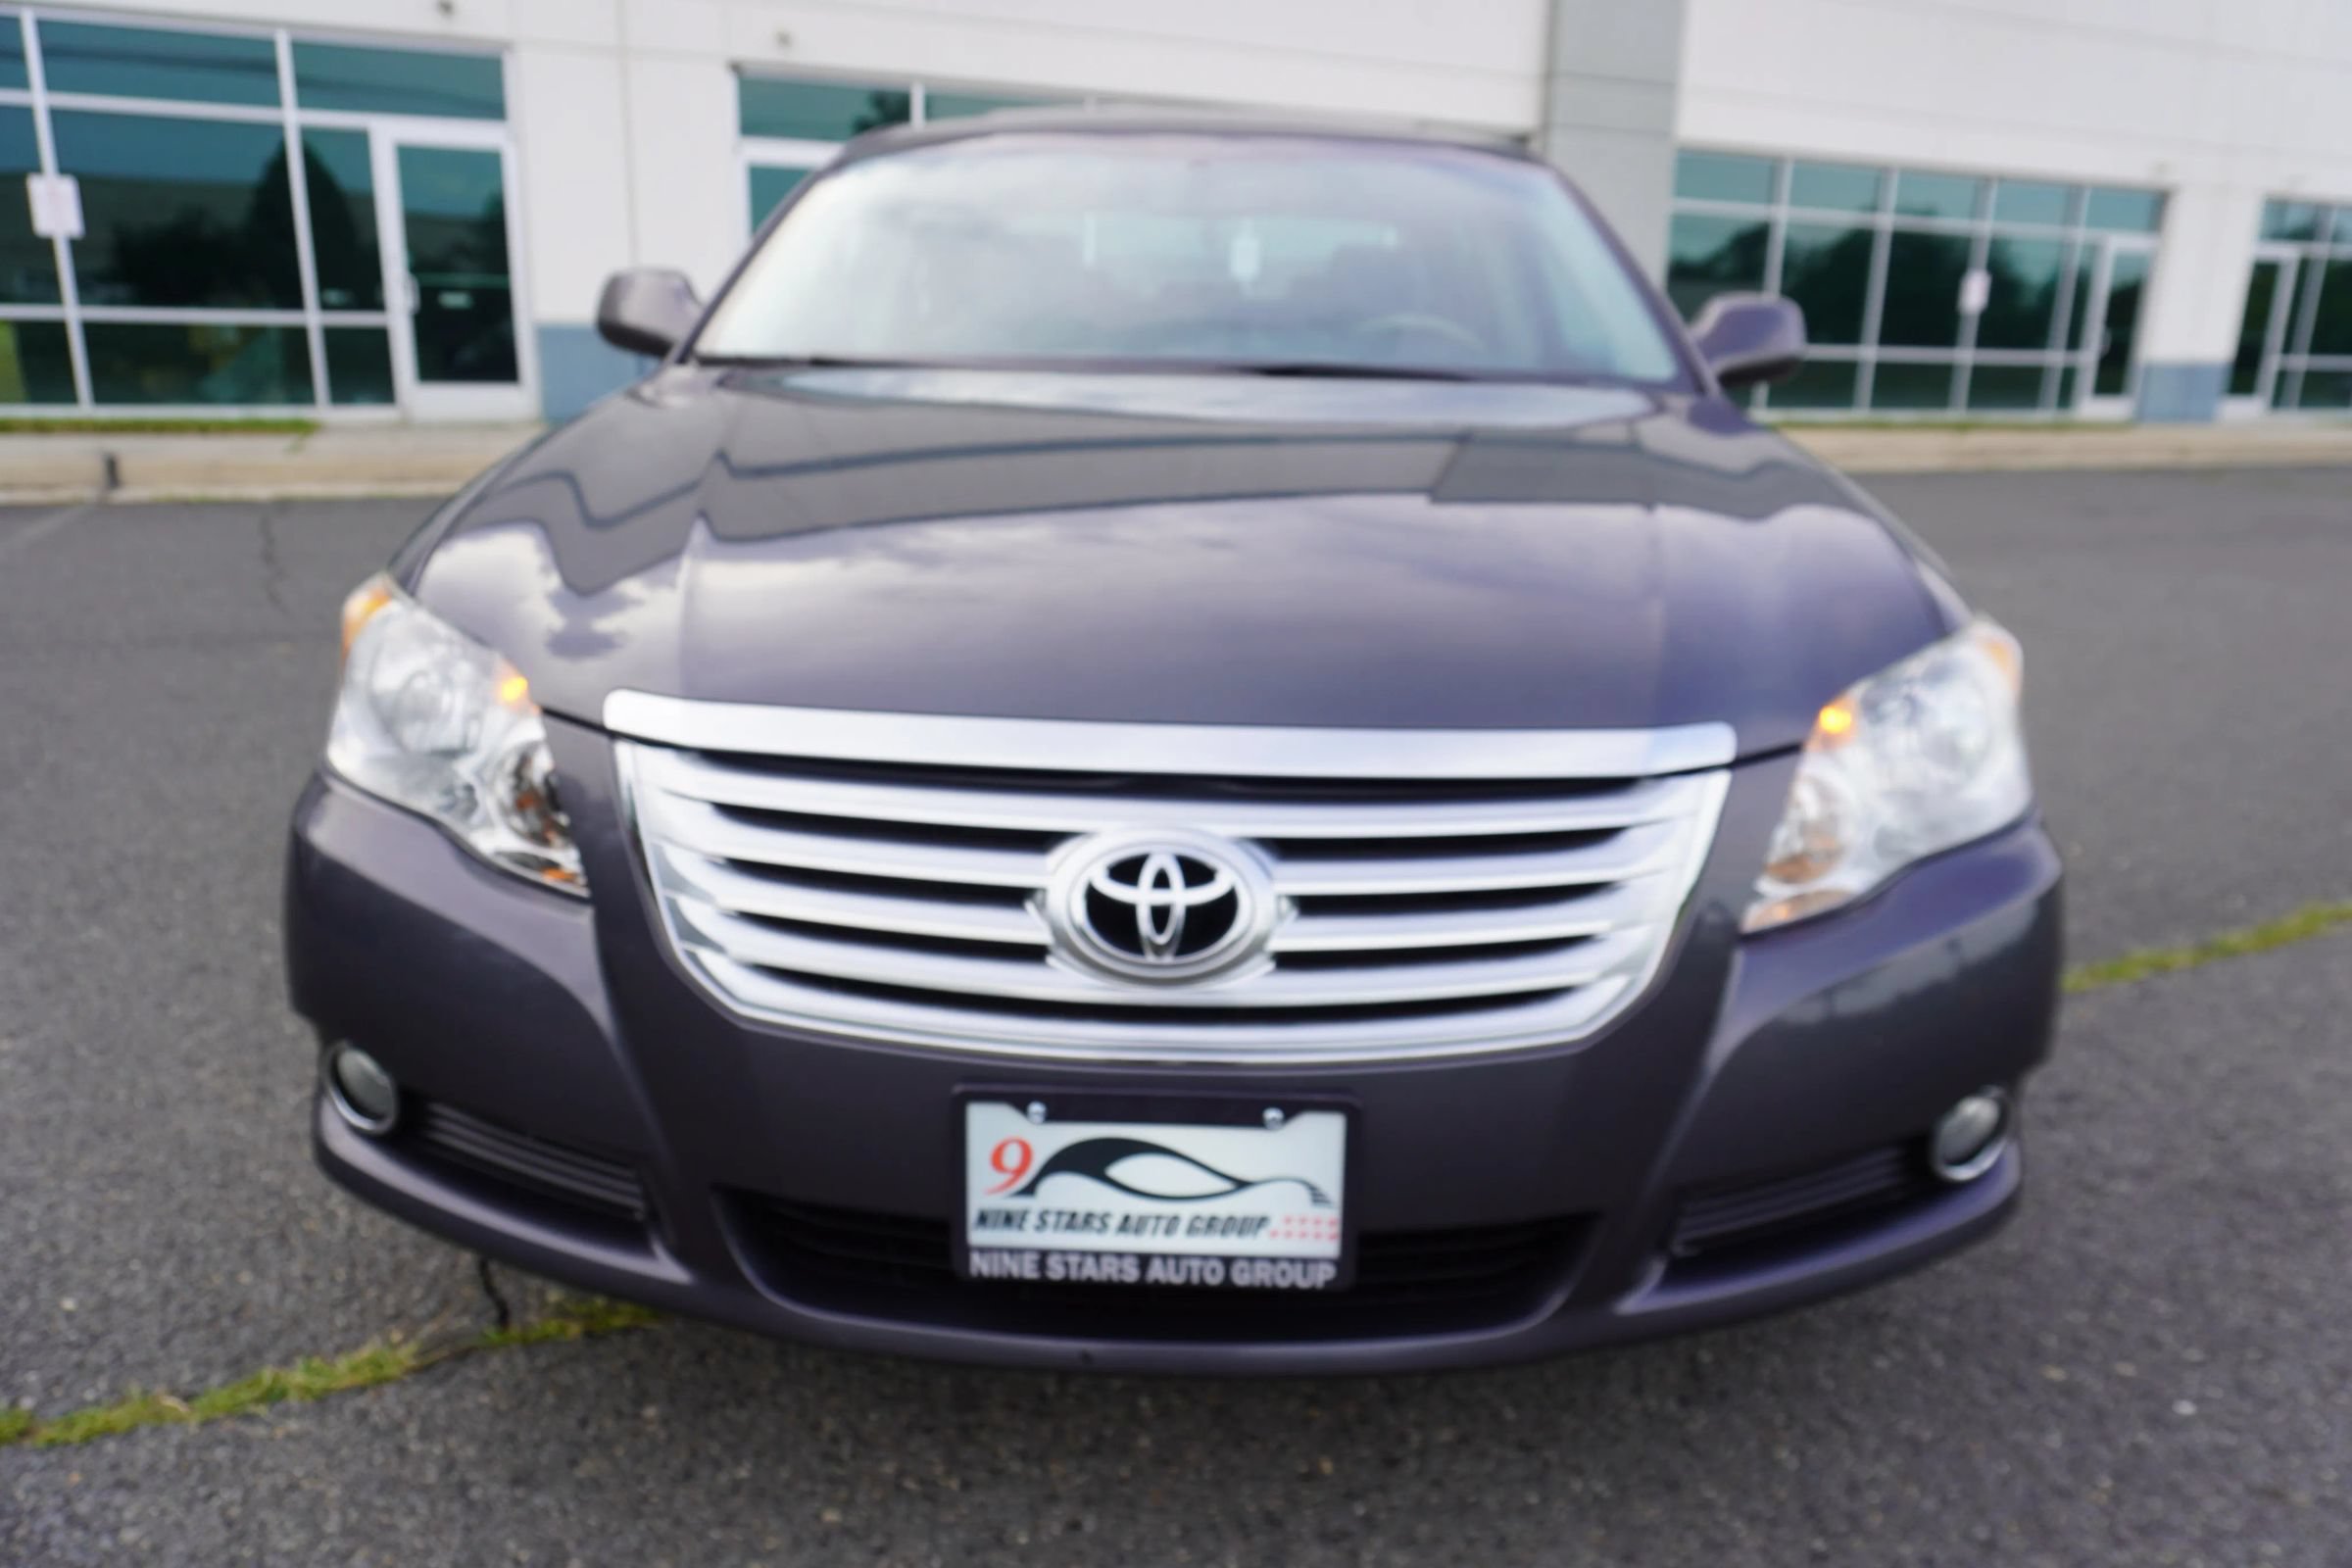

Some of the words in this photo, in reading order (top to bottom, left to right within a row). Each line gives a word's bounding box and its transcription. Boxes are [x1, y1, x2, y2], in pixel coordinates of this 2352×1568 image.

[984, 1137, 1033, 1195] 9
[976, 1209, 1030, 1231] NINE
[1034, 1210, 1111, 1234] STARS
[1115, 1213, 1180, 1236] AUTO
[1186, 1214, 1269, 1238] GROUP
[969, 1250, 1041, 1280] NINE
[1045, 1252, 1140, 1283] STARS
[1145, 1255, 1225, 1286] AUTO
[1230, 1257, 1337, 1289] GROUP
